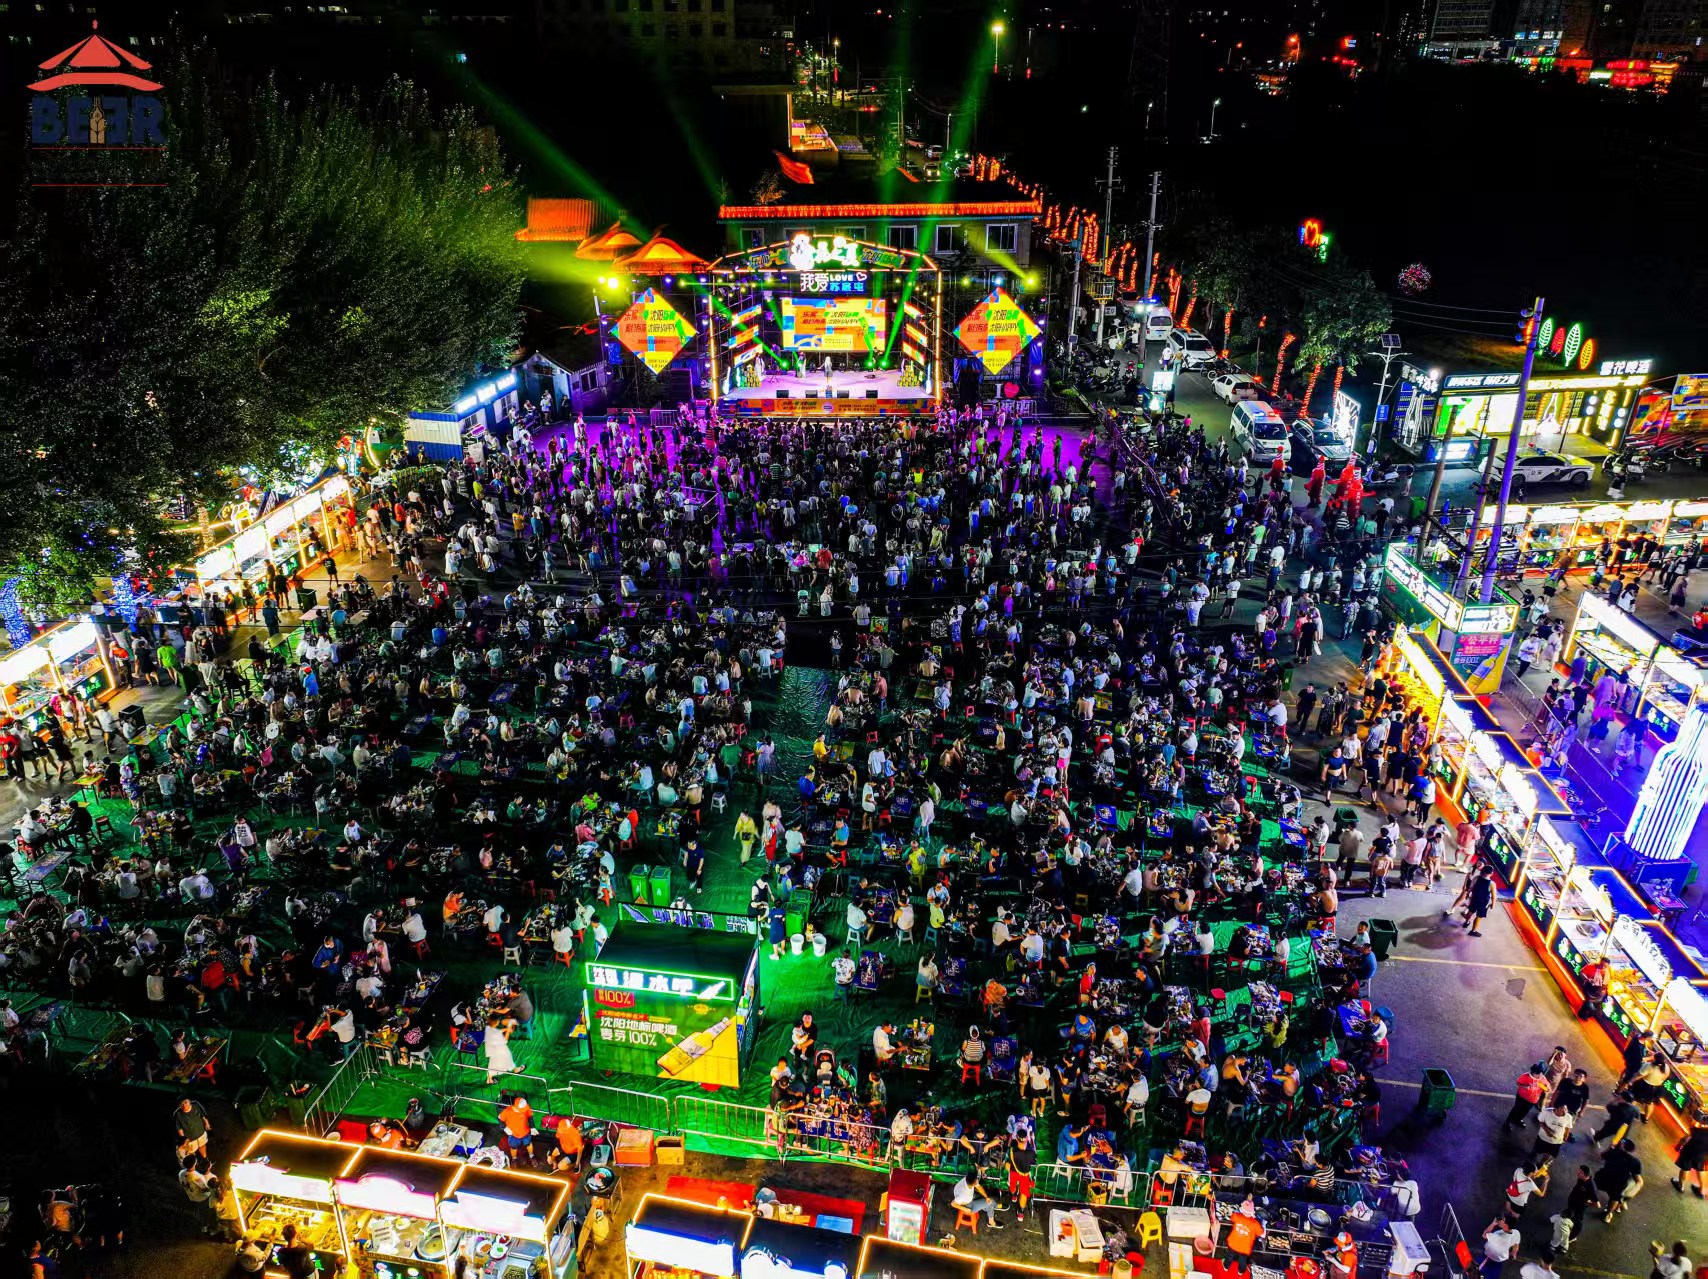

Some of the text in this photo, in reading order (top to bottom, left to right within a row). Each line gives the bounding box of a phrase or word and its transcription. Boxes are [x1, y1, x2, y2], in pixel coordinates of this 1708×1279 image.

[800, 273, 829, 292] 我爱
[830, 274, 854, 282] LOVE
[605, 990, 631, 1005] 100%
